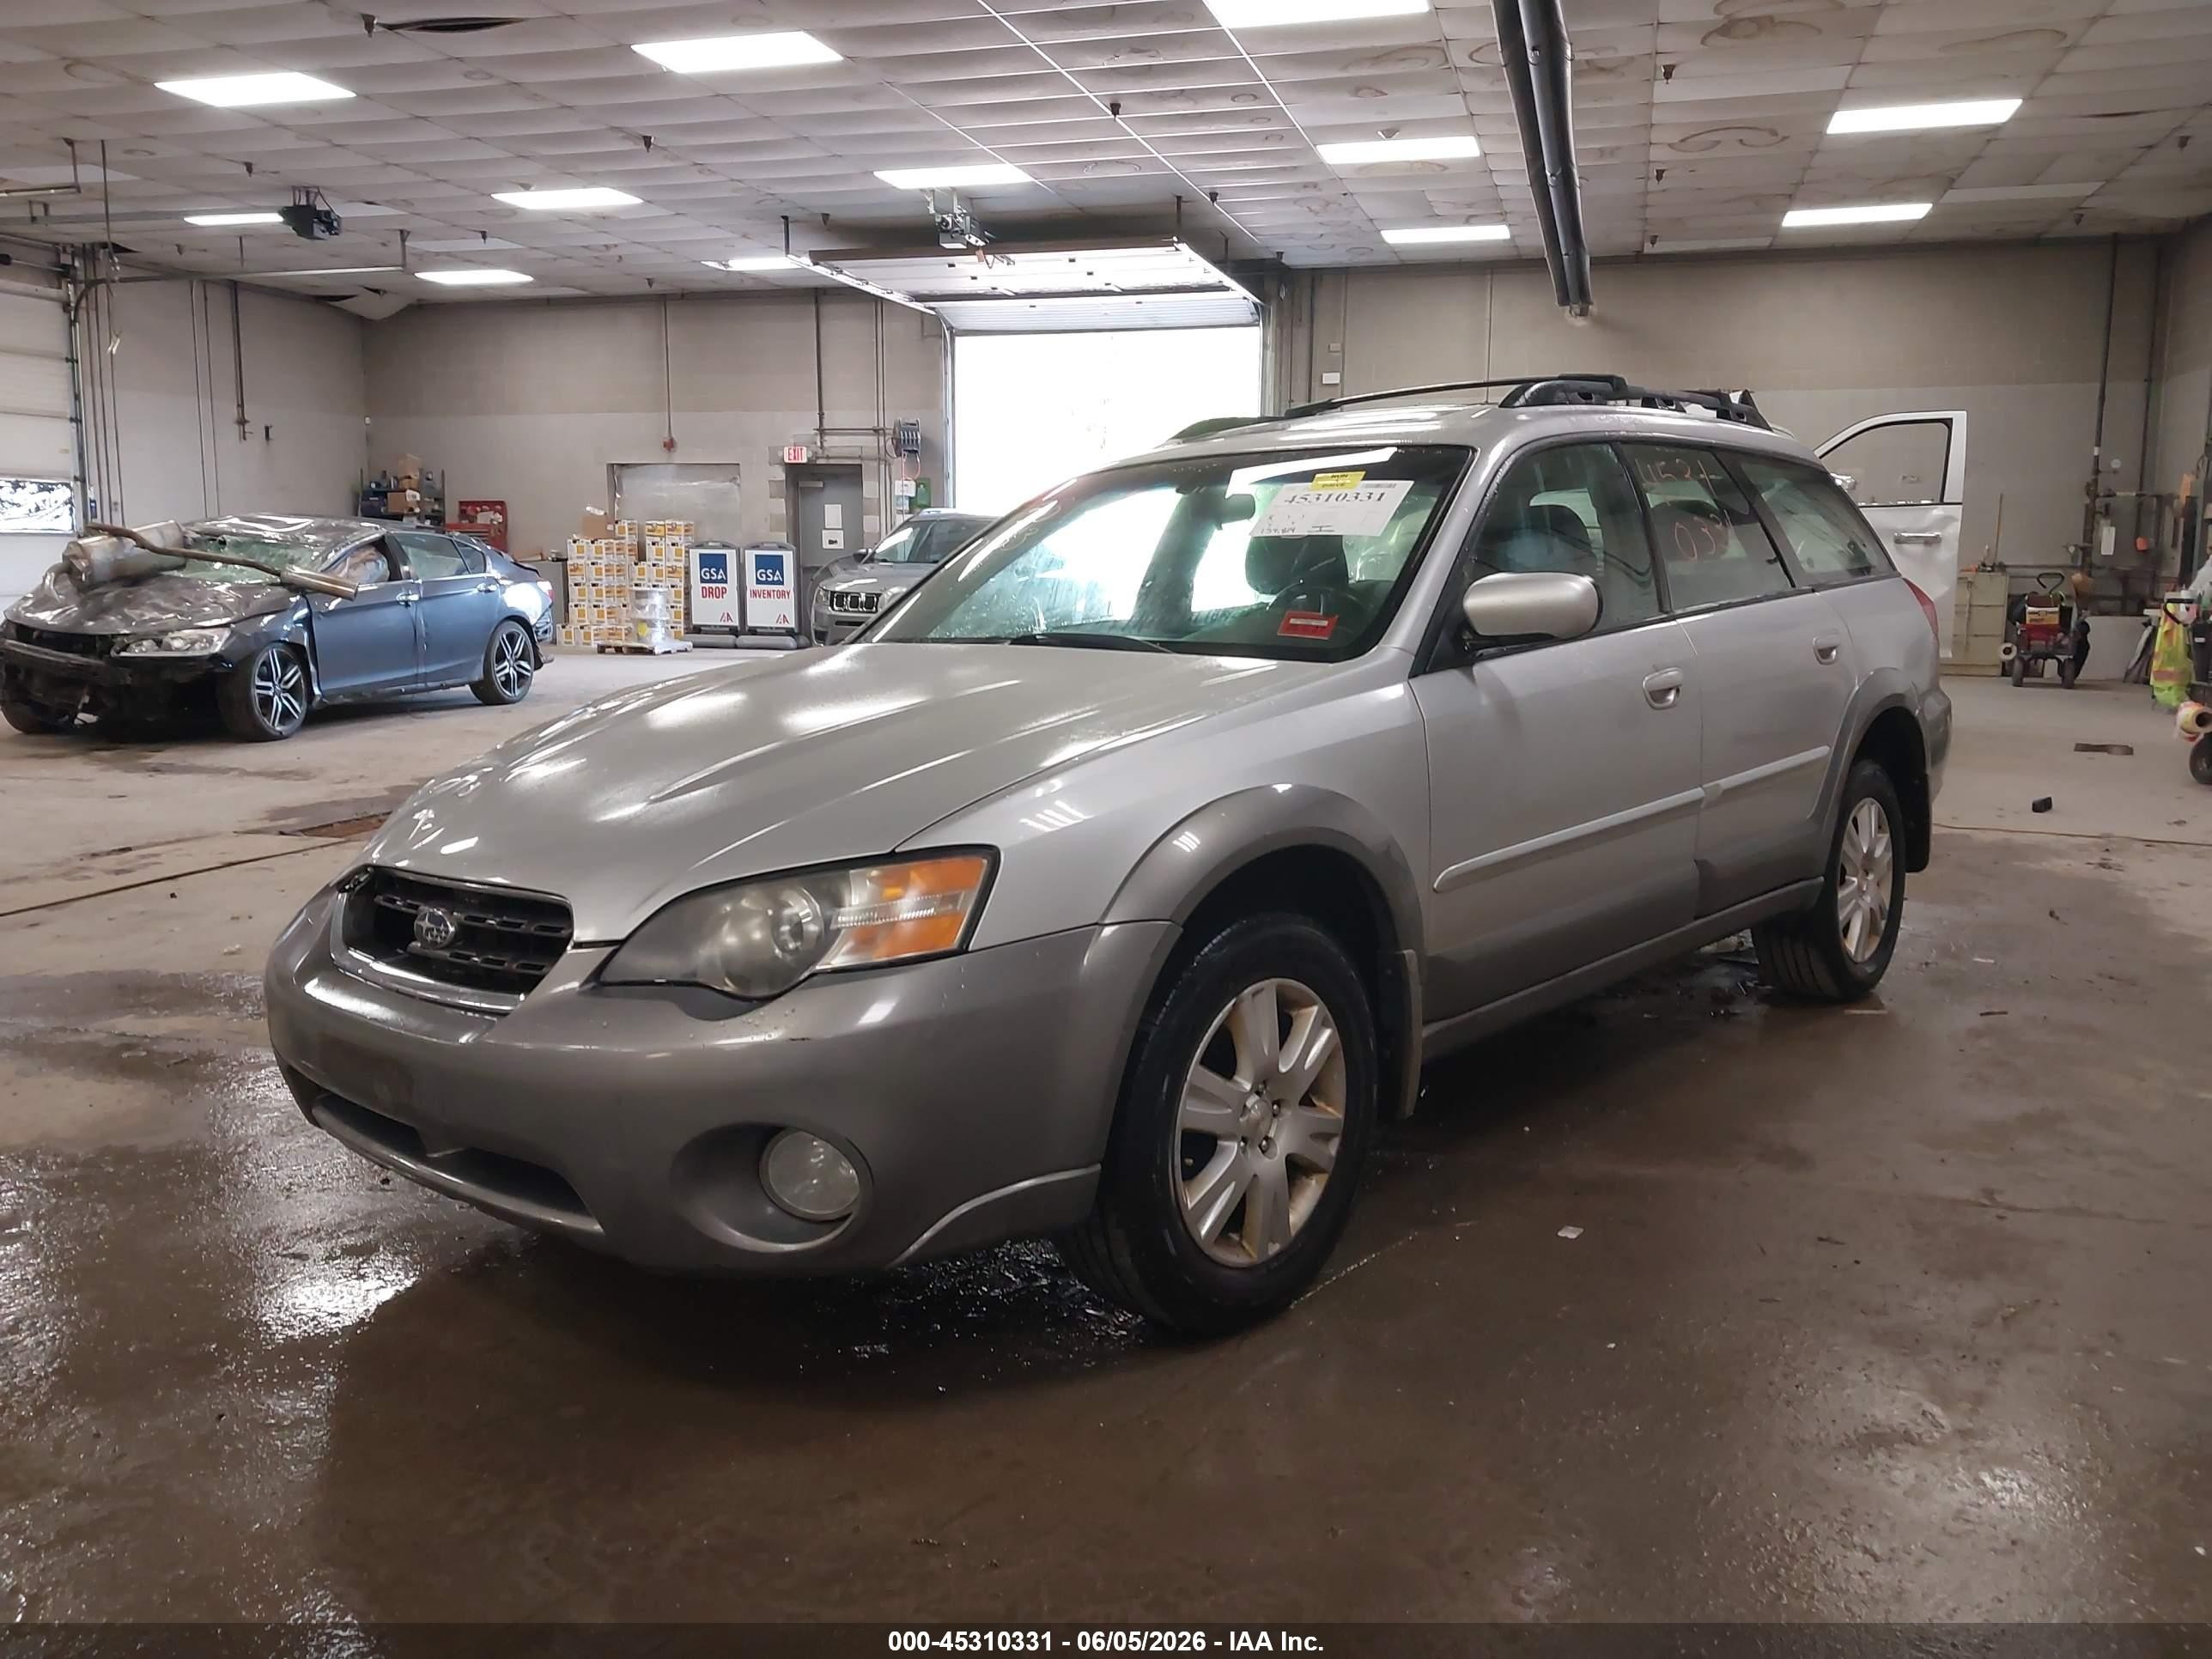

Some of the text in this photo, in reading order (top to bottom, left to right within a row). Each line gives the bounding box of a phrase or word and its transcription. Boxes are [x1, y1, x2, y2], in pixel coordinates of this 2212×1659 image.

[787, 447, 804, 462] EXIT
[1285, 491, 1387, 505] 45310331
[701, 567, 727, 580] GSA
[757, 568, 783, 582] GSA
[701, 586, 727, 599] DROP
[750, 588, 791, 600] INVENTORY
